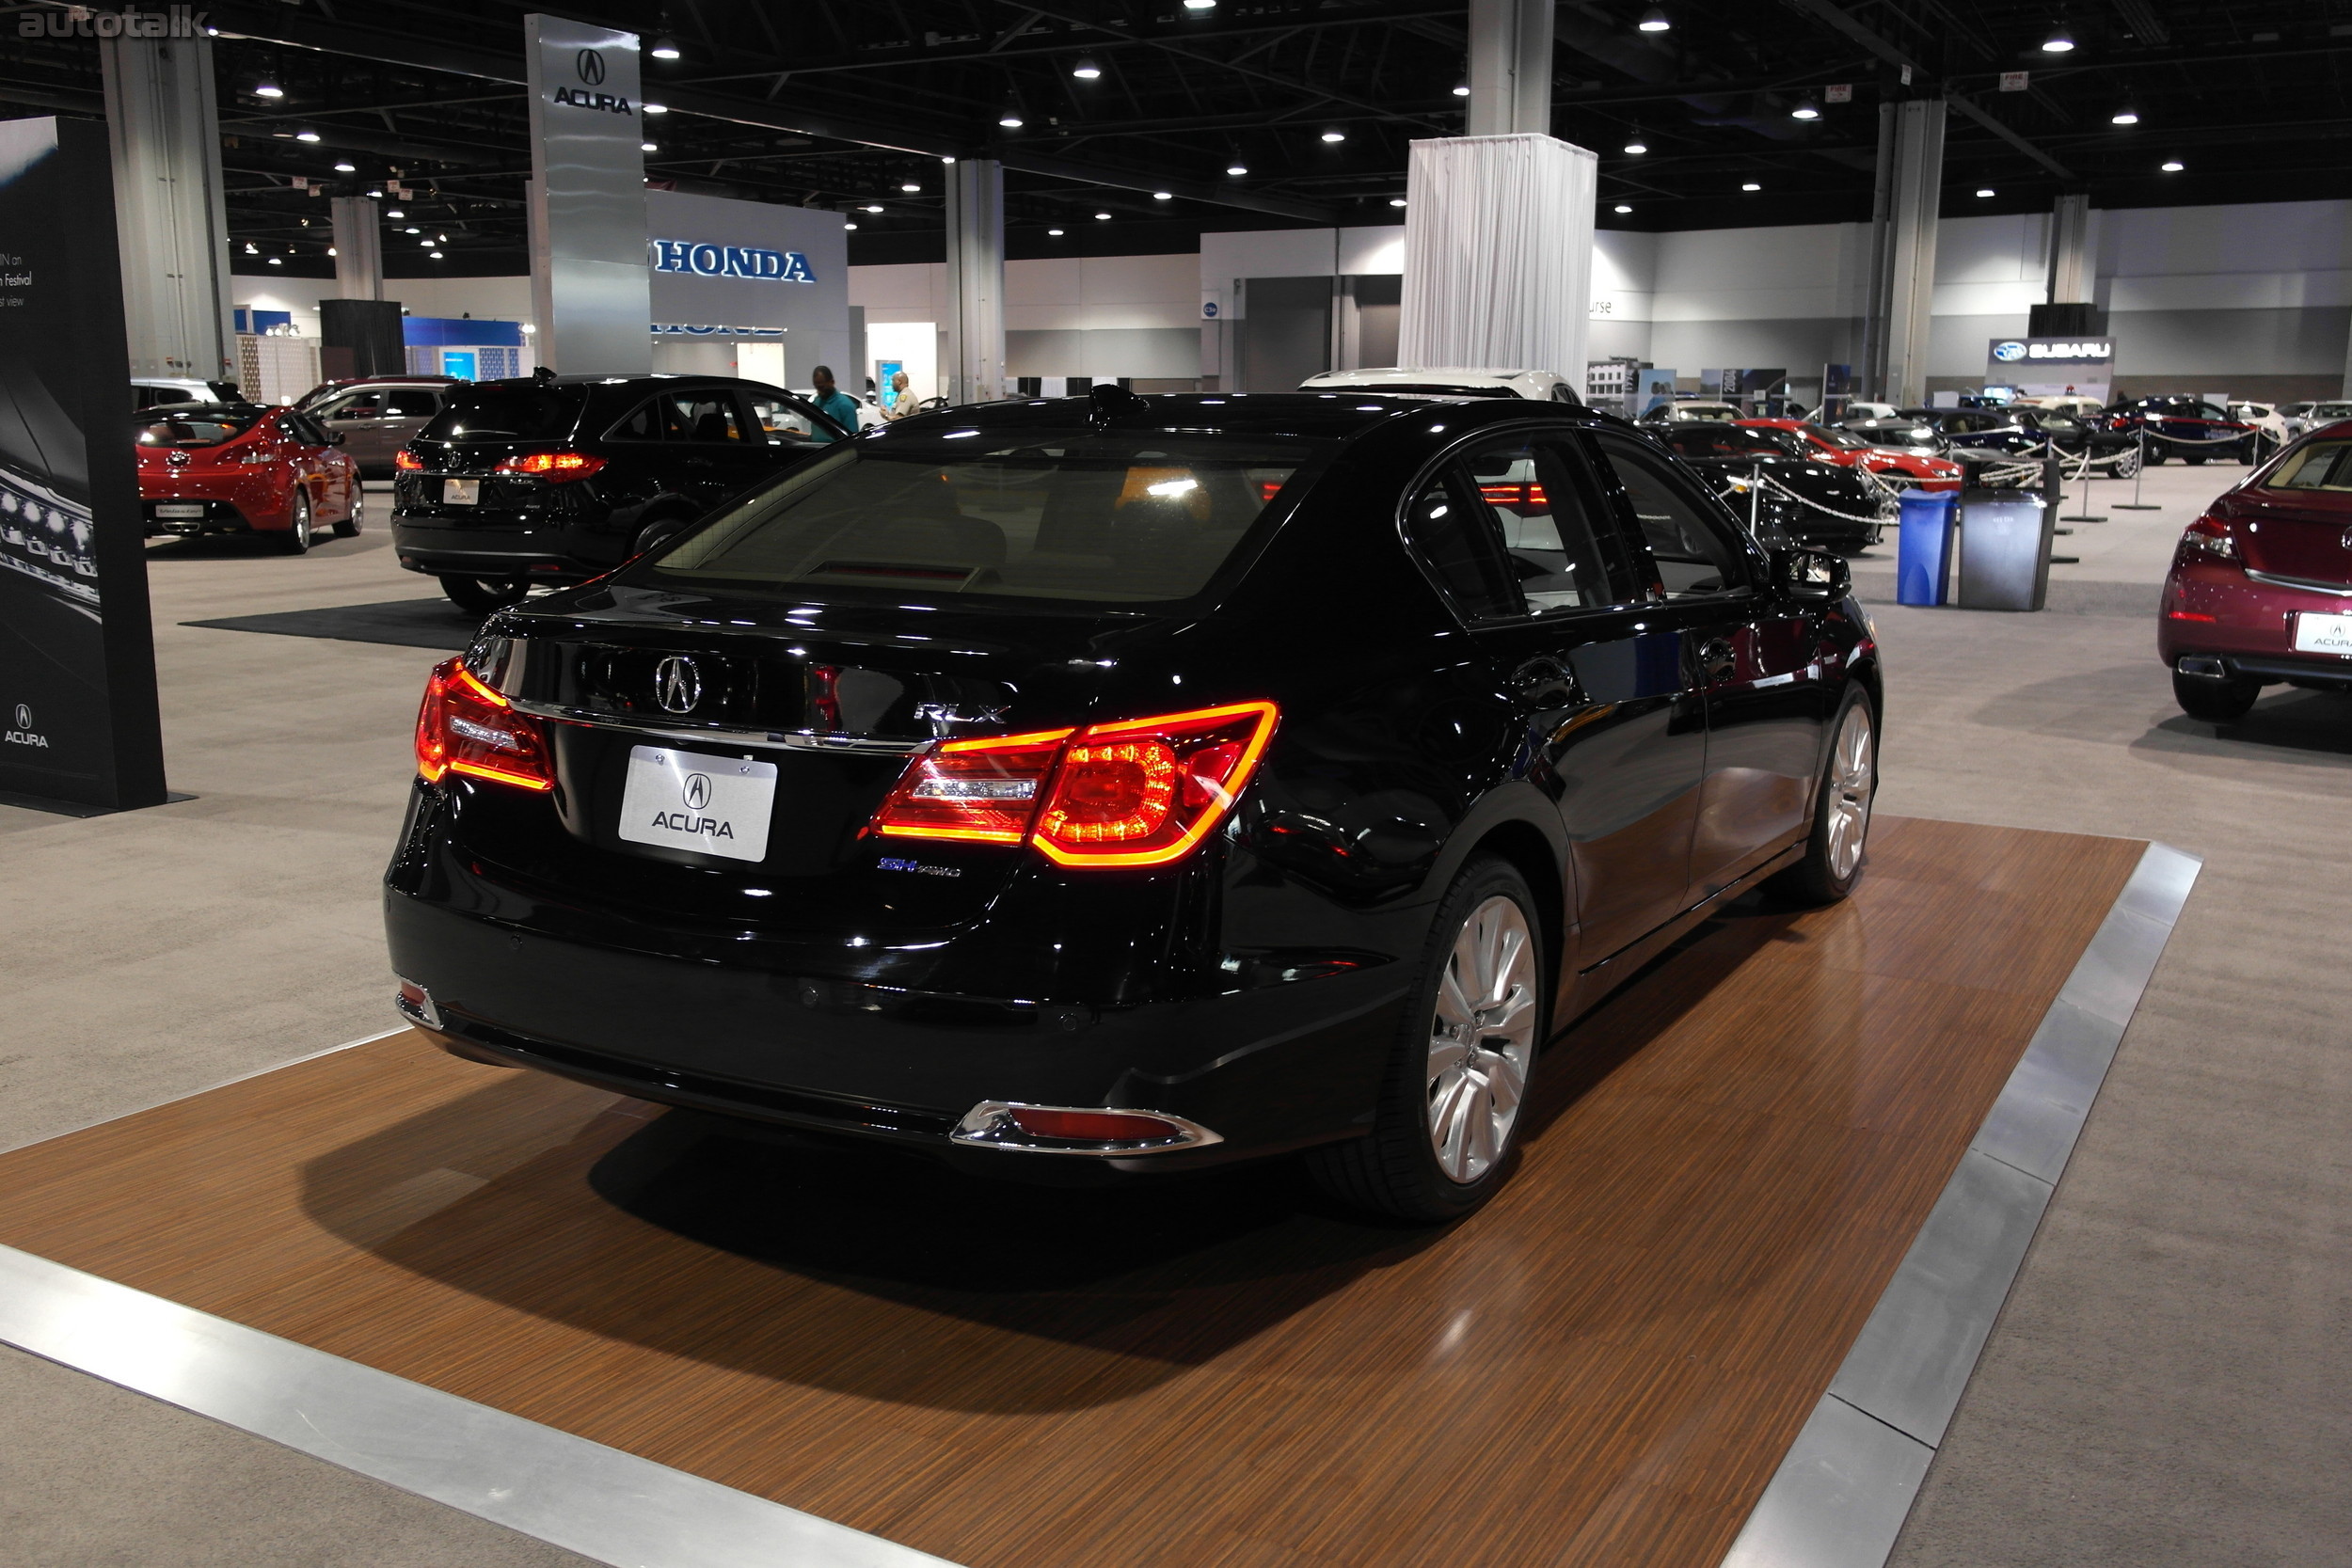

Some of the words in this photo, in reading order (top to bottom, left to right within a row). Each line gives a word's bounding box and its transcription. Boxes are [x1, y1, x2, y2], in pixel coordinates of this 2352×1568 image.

[554, 87, 632, 116] ACURA
[654, 239, 817, 283] HONDA
[5, 271, 32, 286] Festival
[2028, 342, 2111, 358] SUBARU
[914, 702, 1011, 725] RLX
[5, 730, 49, 749] ACURA
[651, 811, 734, 840] ACURA
